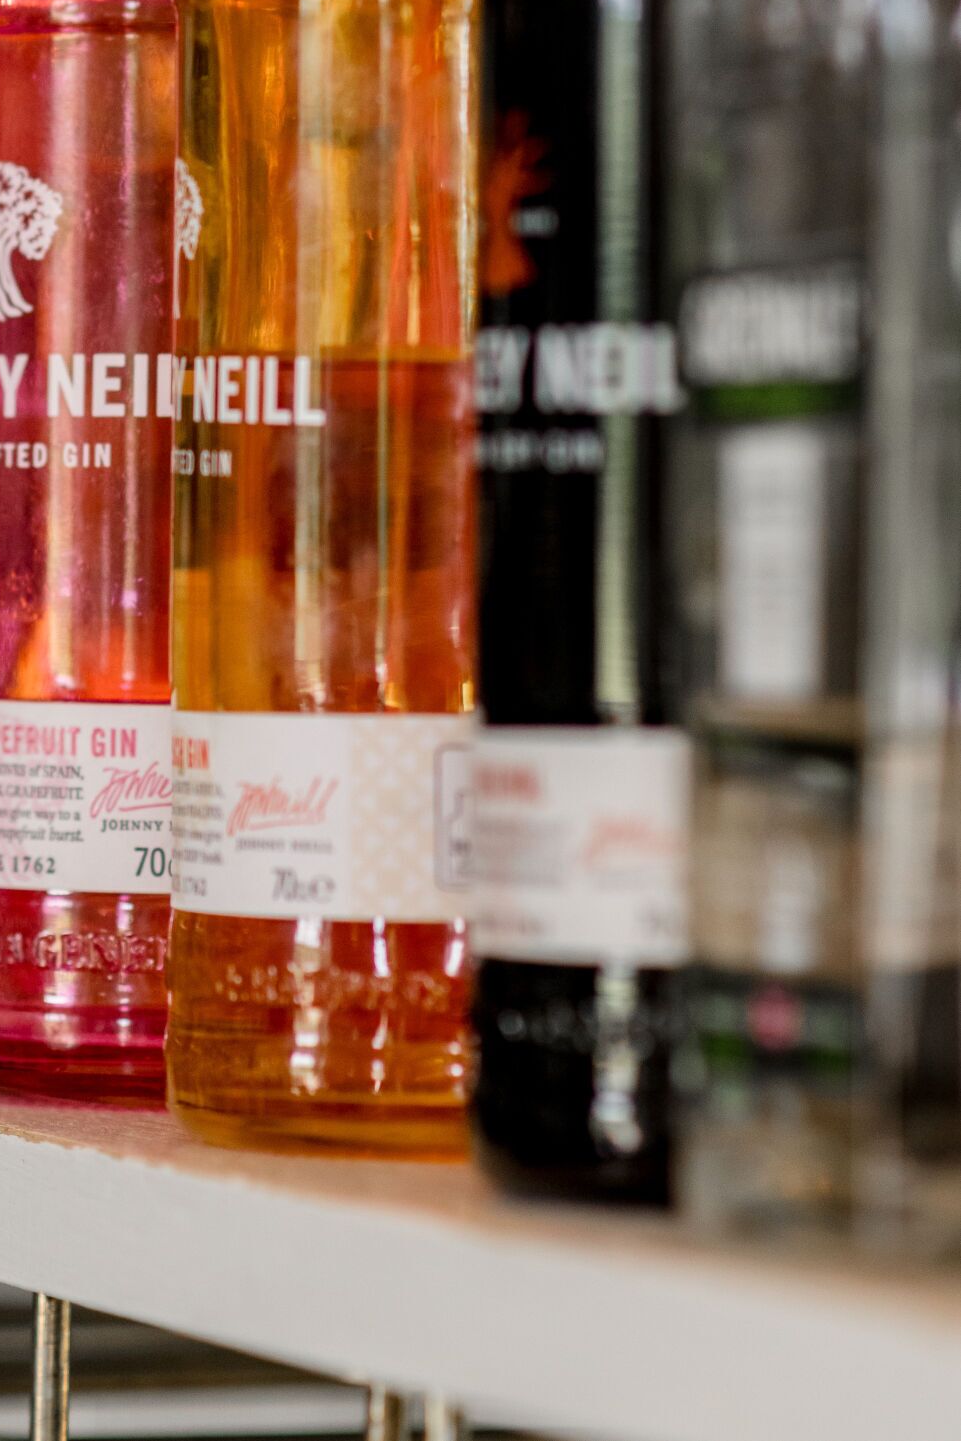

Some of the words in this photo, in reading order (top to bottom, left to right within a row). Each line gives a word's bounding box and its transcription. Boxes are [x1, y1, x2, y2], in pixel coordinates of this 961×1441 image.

[193, 355, 326, 426] NEILL
[62, 442, 113, 468] GIN
[199, 449, 233, 478] GIN
[91, 726, 137, 758] GIN
[101, 818, 164, 833] JOHNNY
[12, 855, 56, 875] 1762
